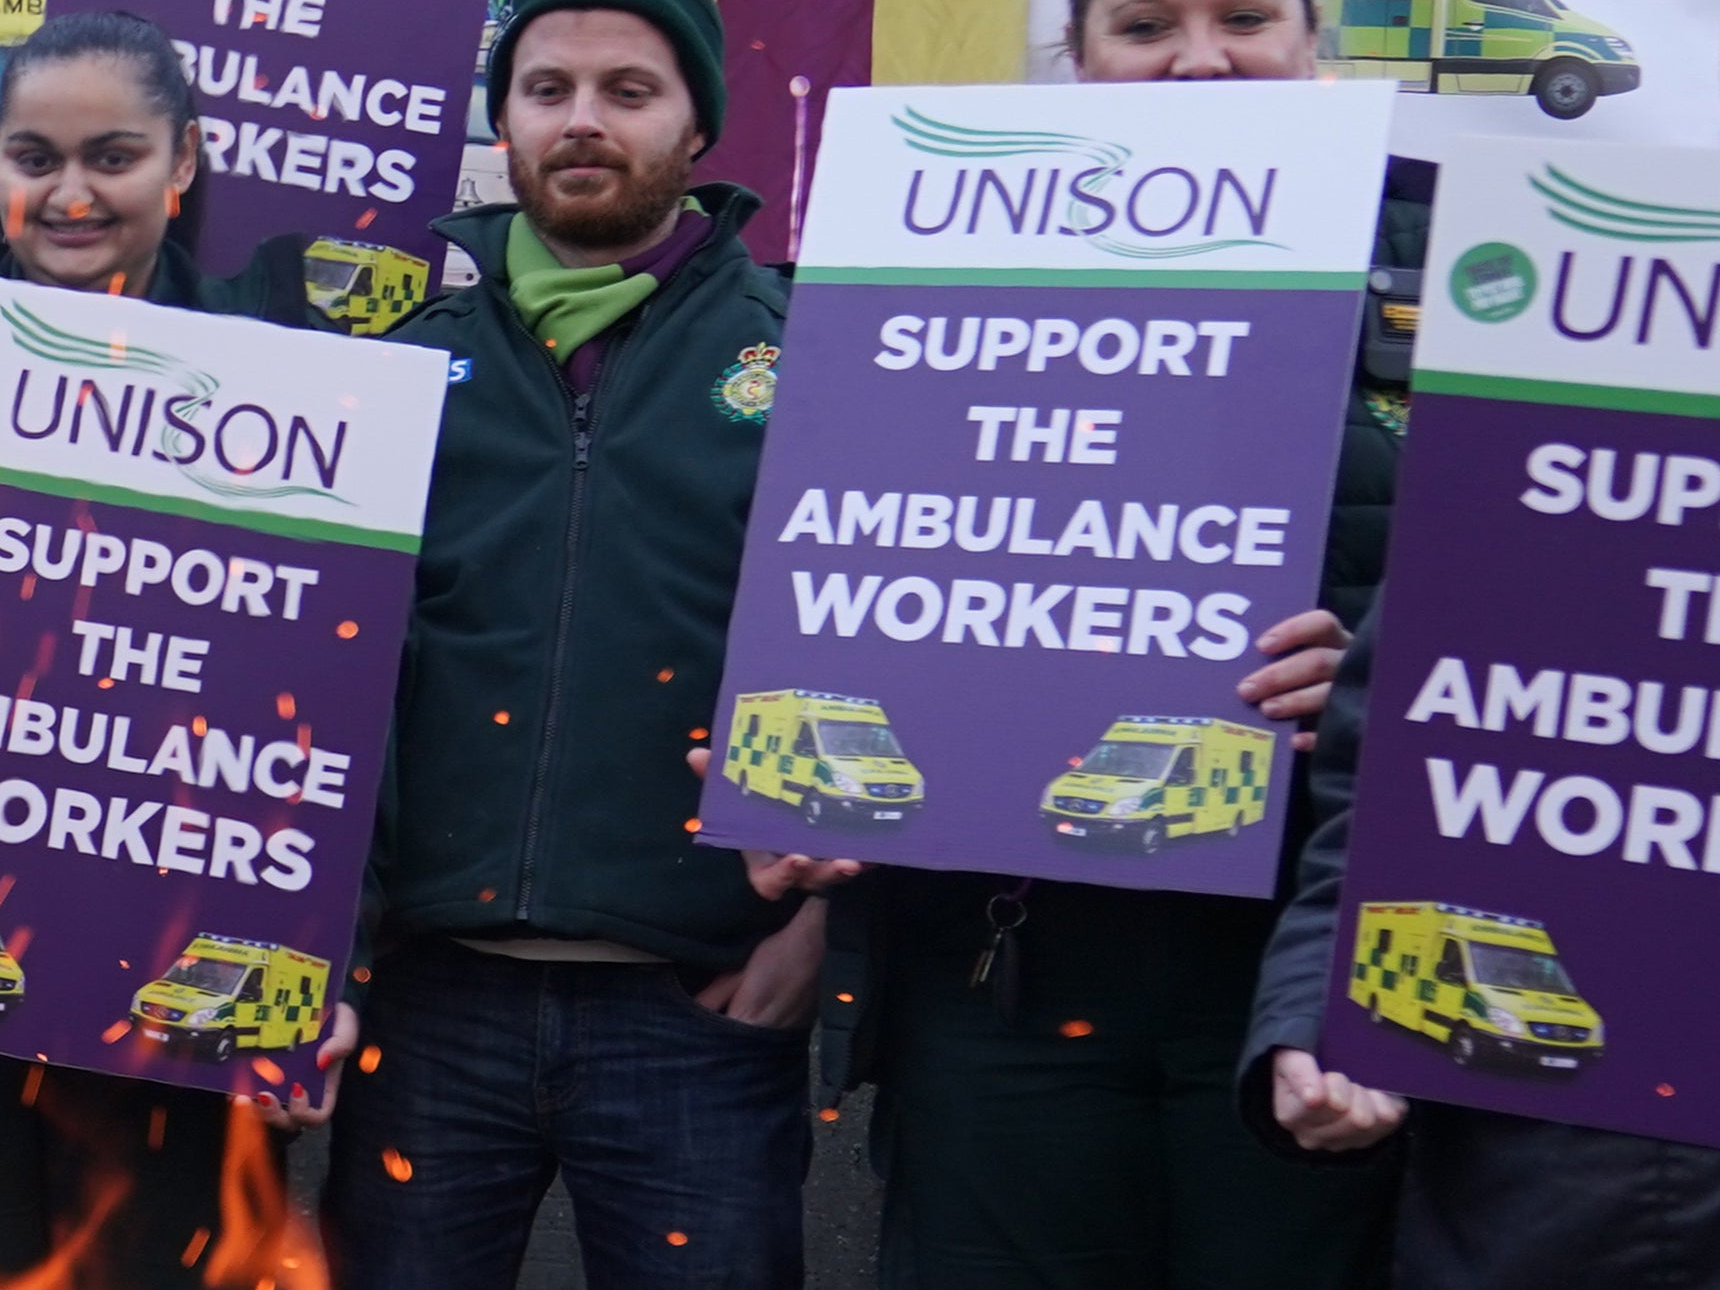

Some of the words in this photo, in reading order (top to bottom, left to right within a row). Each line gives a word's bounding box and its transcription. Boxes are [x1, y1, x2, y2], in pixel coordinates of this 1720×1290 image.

[171, 40, 447, 136] BULANCE
[198, 116, 418, 204] RKERS
[902, 166, 1278, 238] UNISON
[874, 315, 1250, 378] SUPPORT
[10, 368, 348, 491] UNISON
[967, 406, 1123, 466] THE
[779, 488, 1291, 568] AMBULANCE
[72, 619, 211, 694] THE
[791, 571, 1252, 664] WORKERS
